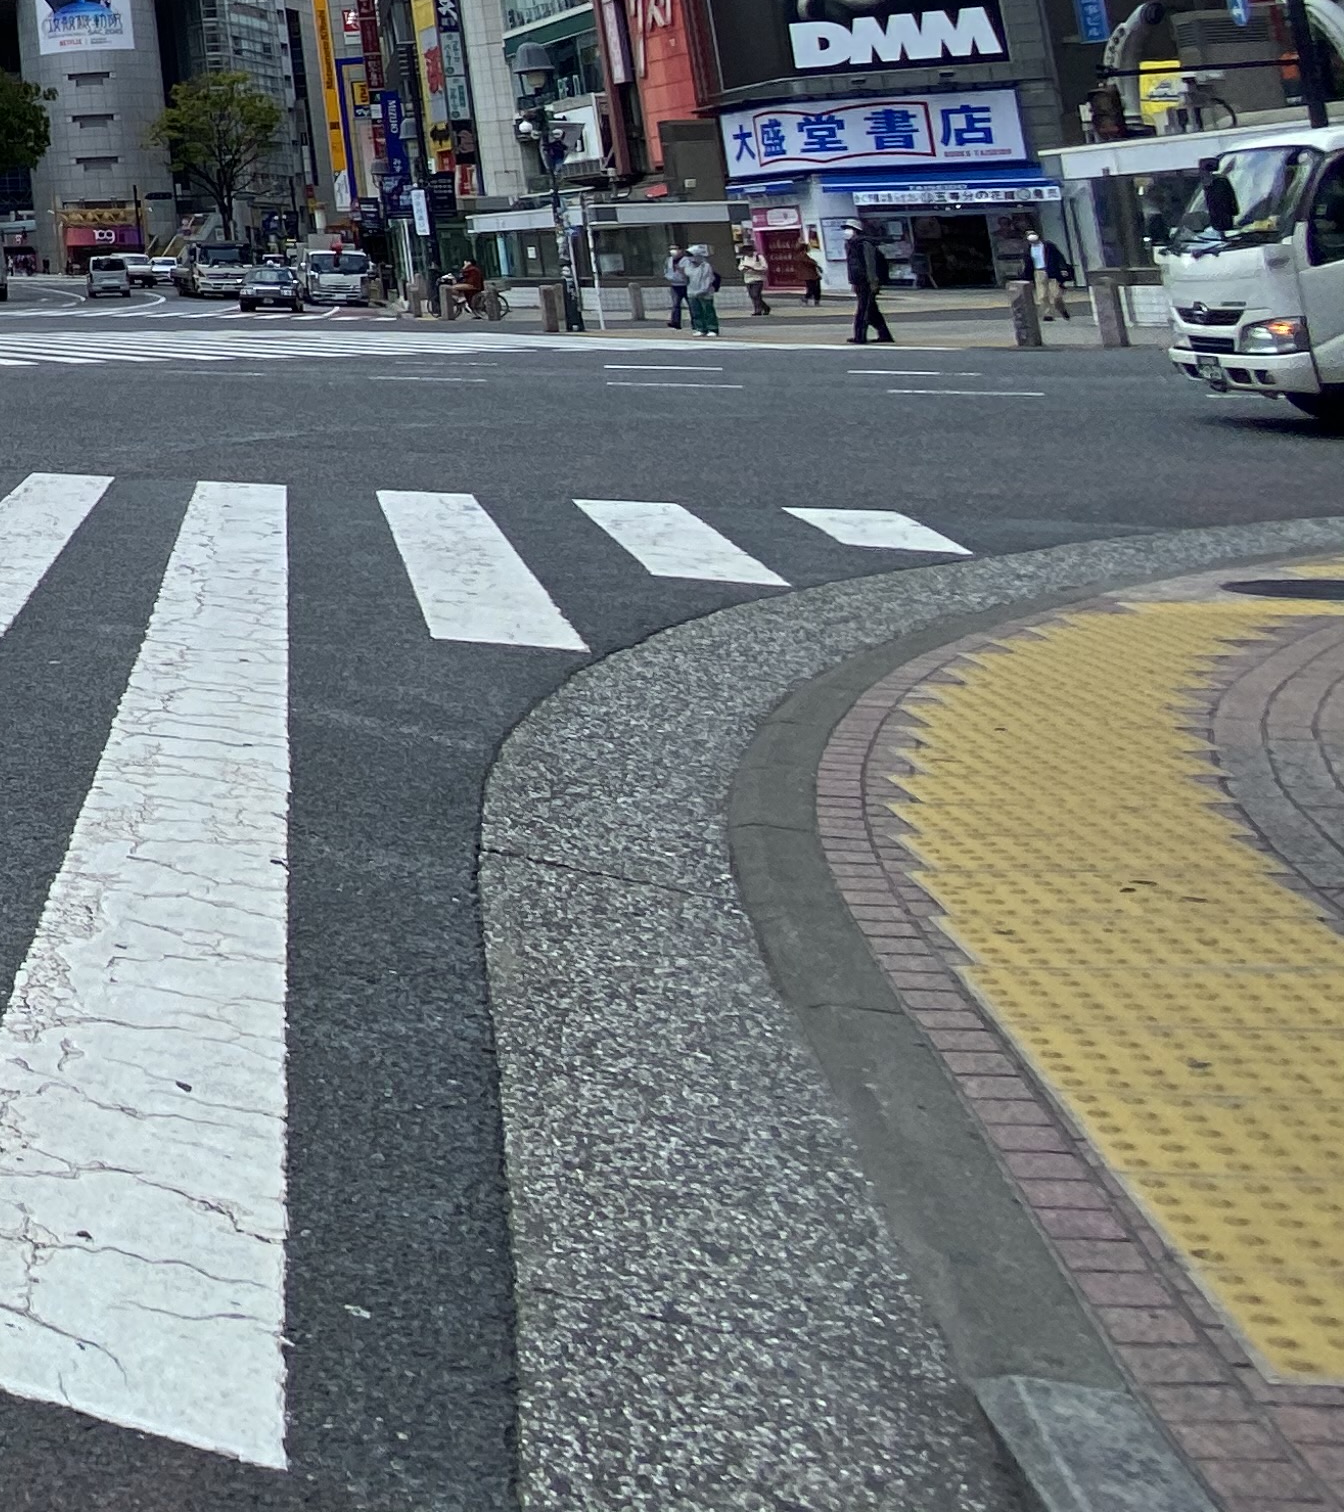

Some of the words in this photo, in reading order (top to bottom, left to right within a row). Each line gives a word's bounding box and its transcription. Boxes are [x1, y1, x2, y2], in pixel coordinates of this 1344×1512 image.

[789, 6, 1003, 69] DMM
[733, 105, 994, 161] 大盛堂書店
